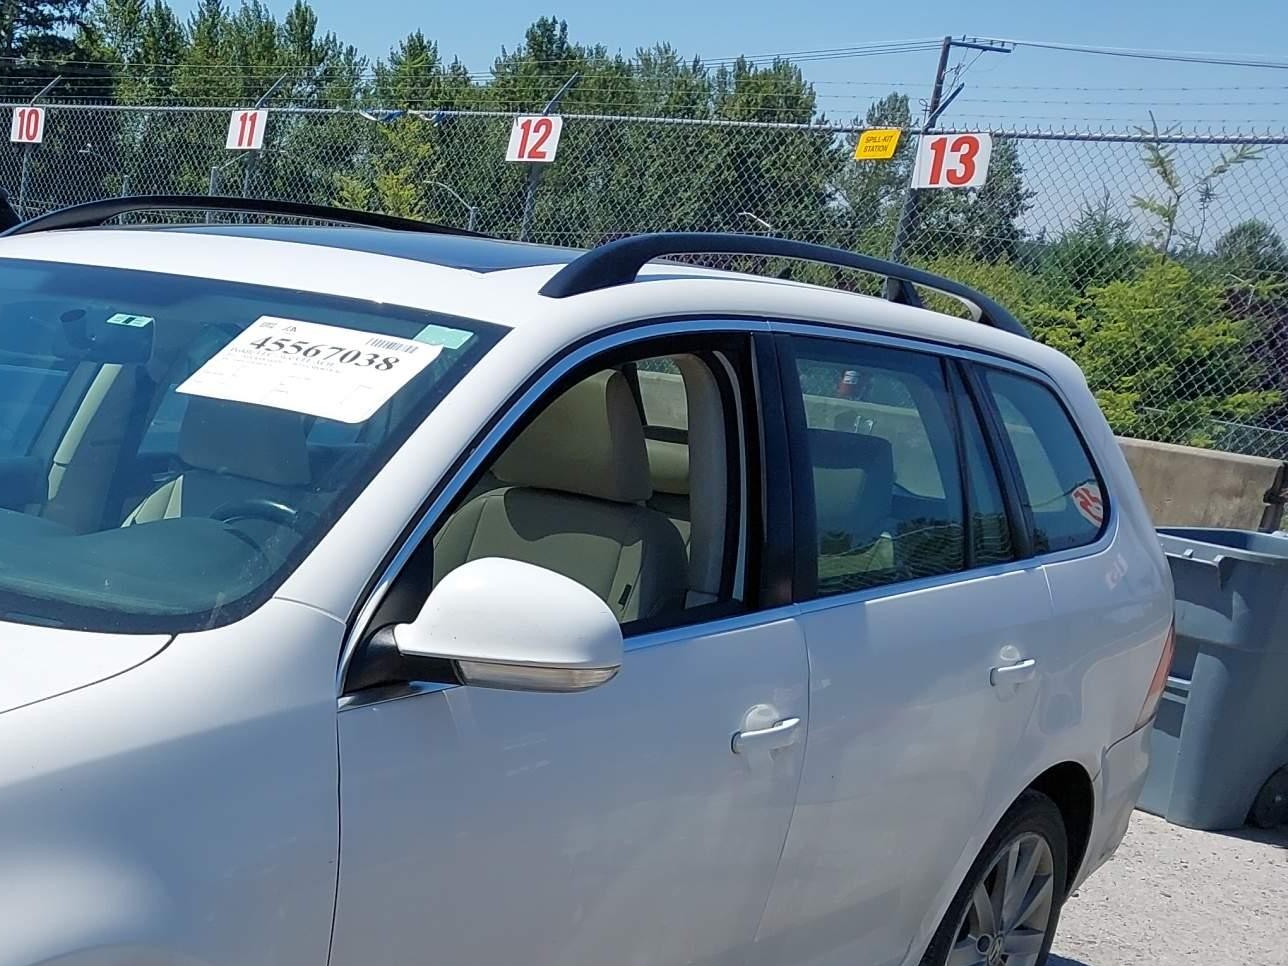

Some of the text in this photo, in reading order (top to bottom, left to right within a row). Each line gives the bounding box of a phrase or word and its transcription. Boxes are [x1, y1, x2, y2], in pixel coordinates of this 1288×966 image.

[17, 108, 40, 141] 10
[236, 112, 258, 147] 11
[518, 118, 553, 159] 12
[928, 134, 980, 186] 13
[250, 336, 400, 372] 45567038
